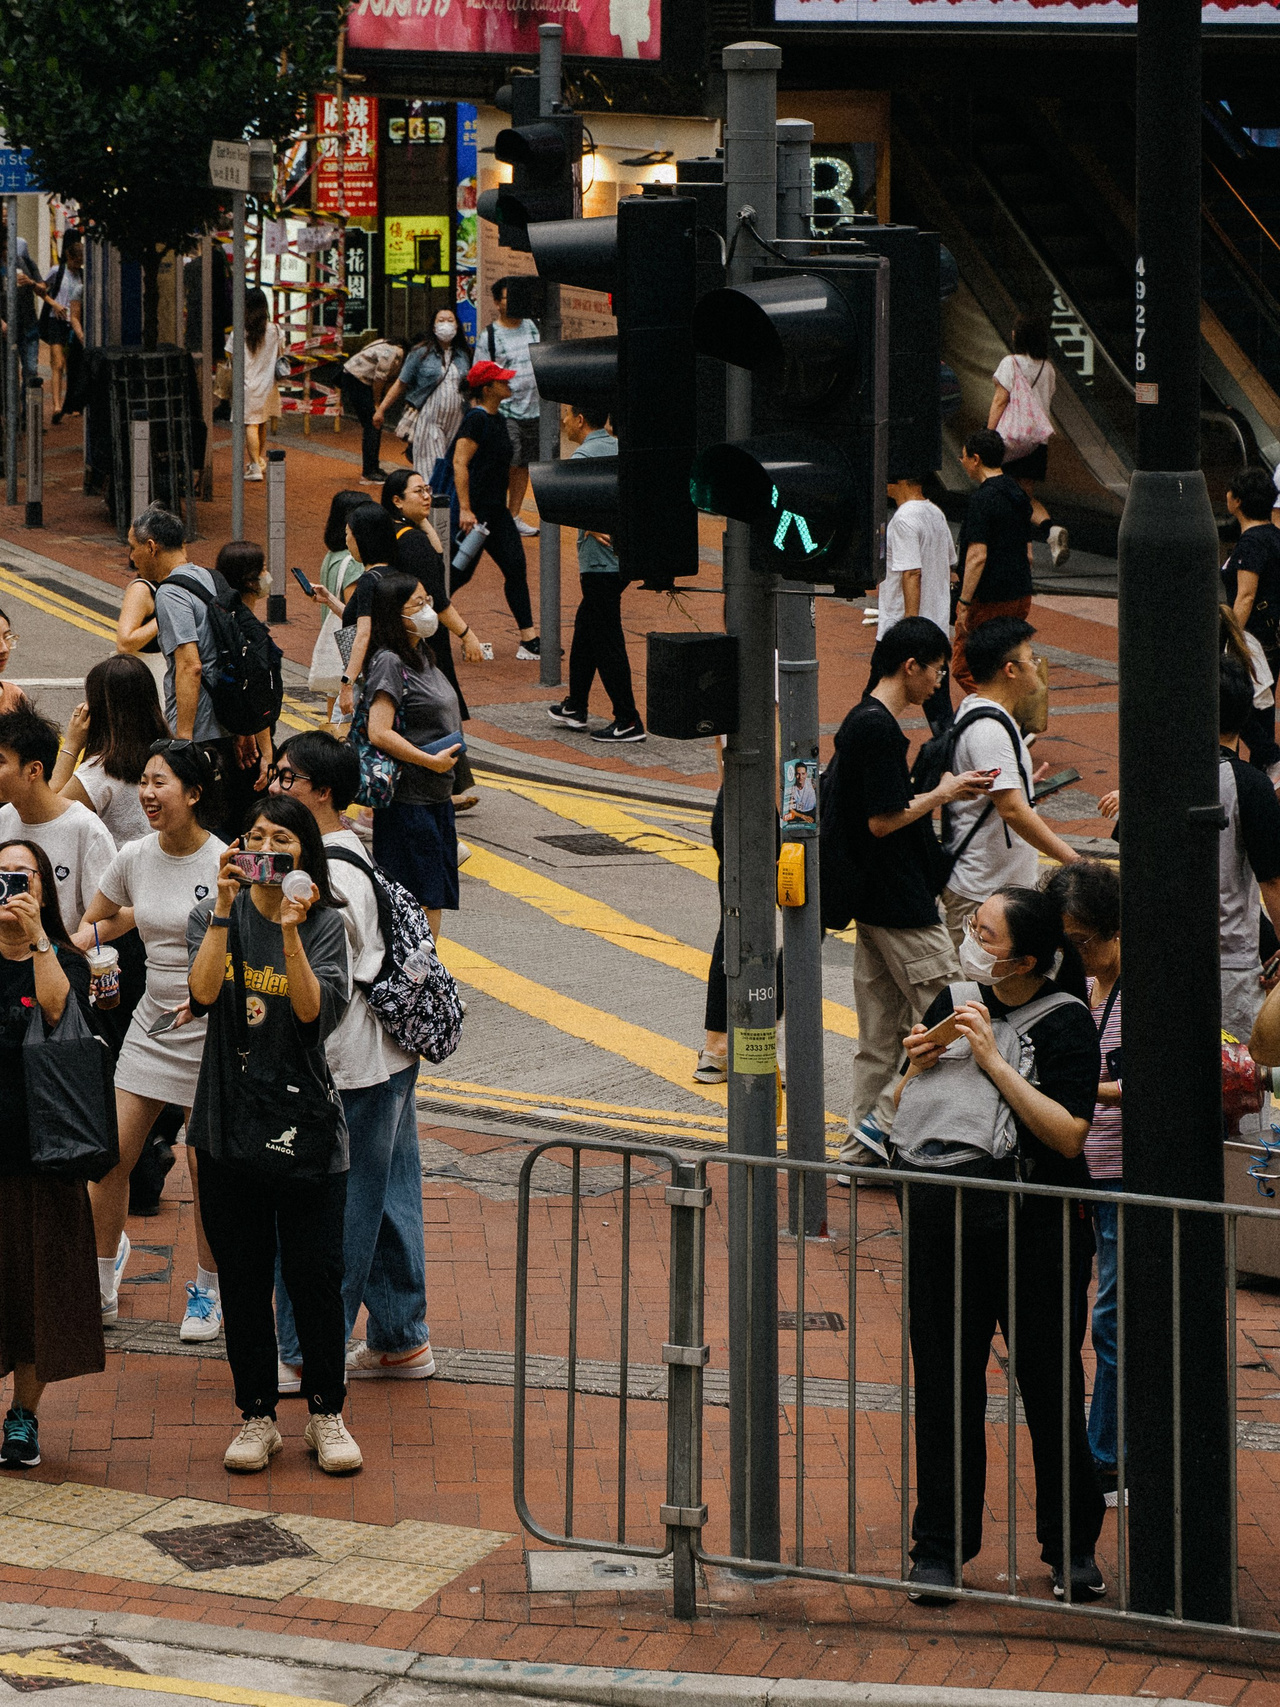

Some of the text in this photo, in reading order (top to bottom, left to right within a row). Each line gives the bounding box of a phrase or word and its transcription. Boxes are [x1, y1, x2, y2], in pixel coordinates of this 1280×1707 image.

[1135, 256, 1146, 371] 49278
[745, 1044, 763, 1052] 2333
[265, 1142, 296, 1157] KANGOL
